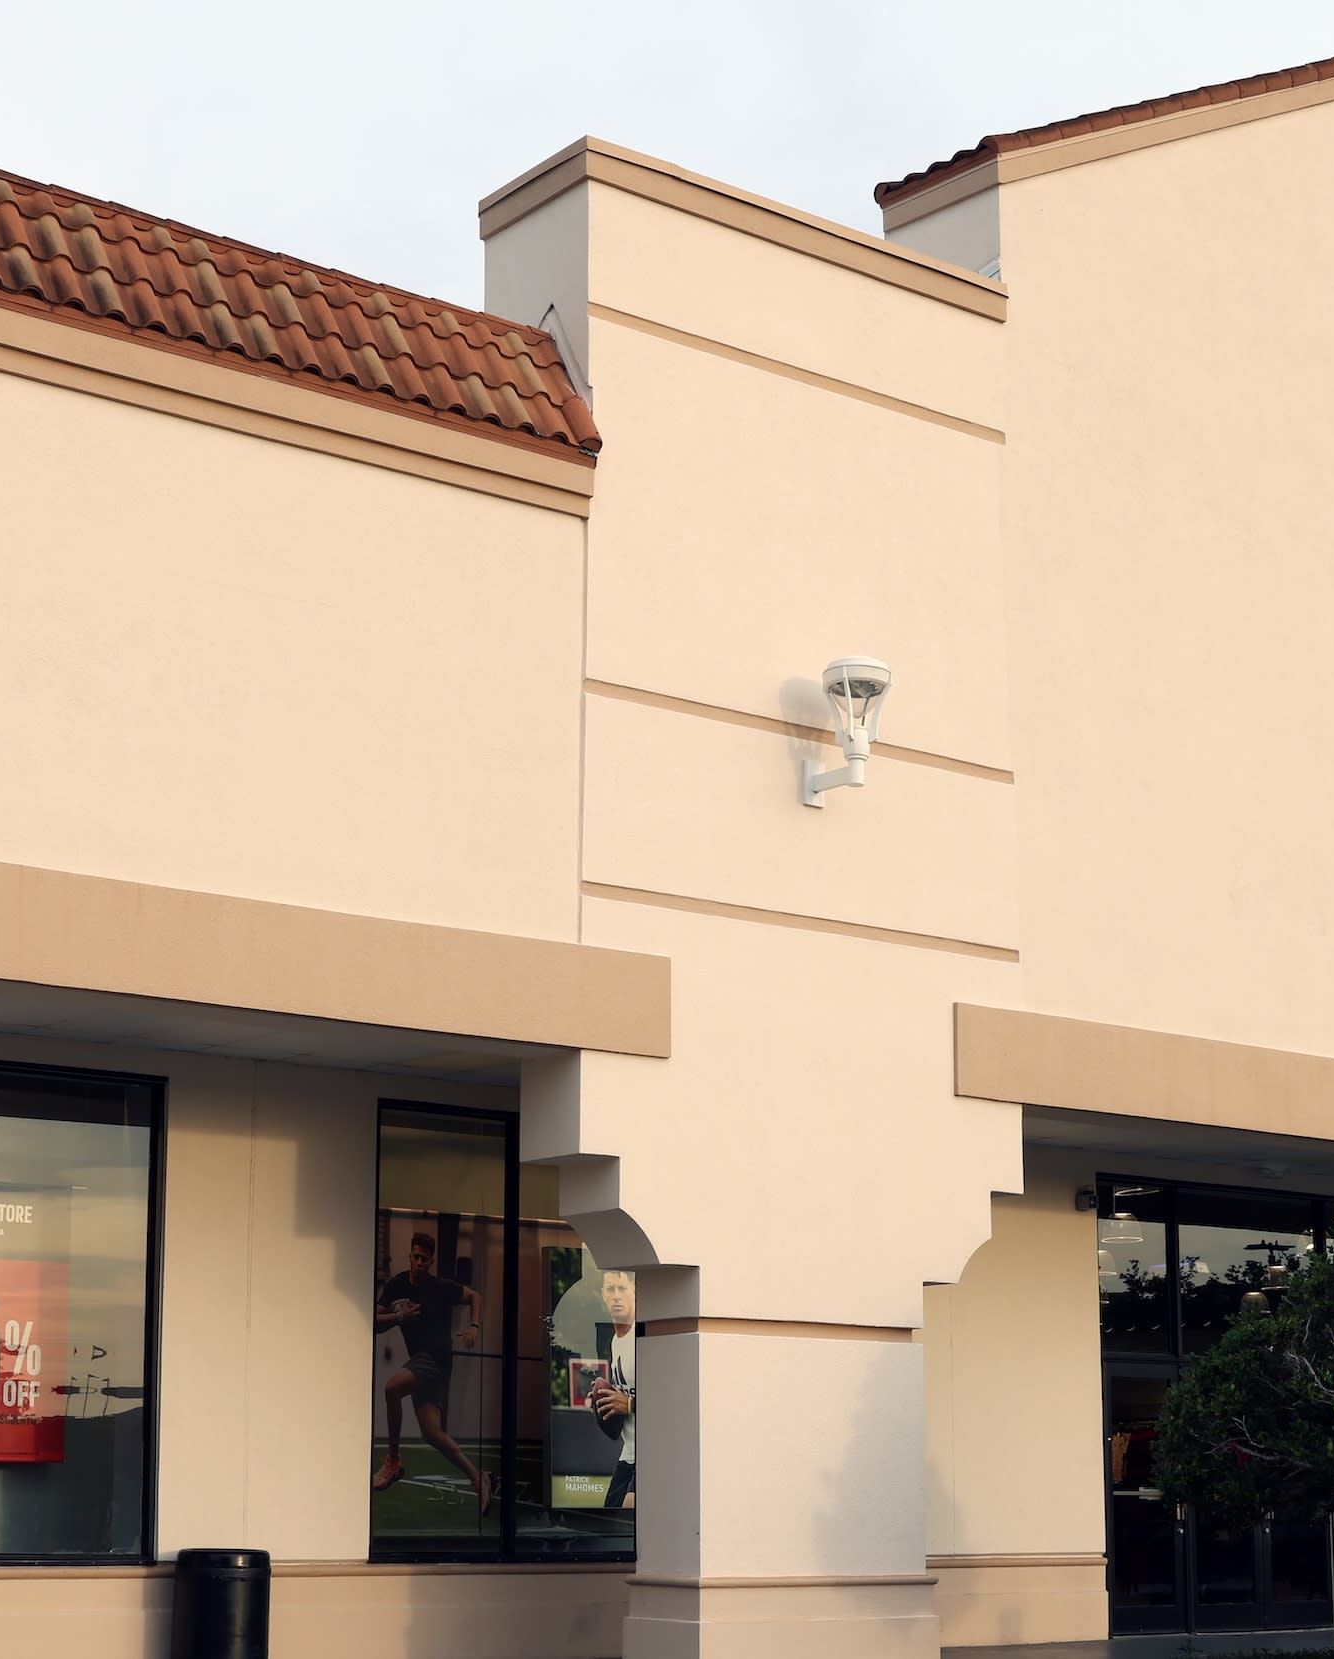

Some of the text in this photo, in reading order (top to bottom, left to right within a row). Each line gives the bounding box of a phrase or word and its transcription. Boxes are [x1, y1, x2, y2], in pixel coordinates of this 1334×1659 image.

[2, 1379, 41, 1408] OFF
[565, 1475, 589, 1484] PATRICK
[565, 1483, 604, 1493] MAHOMES
